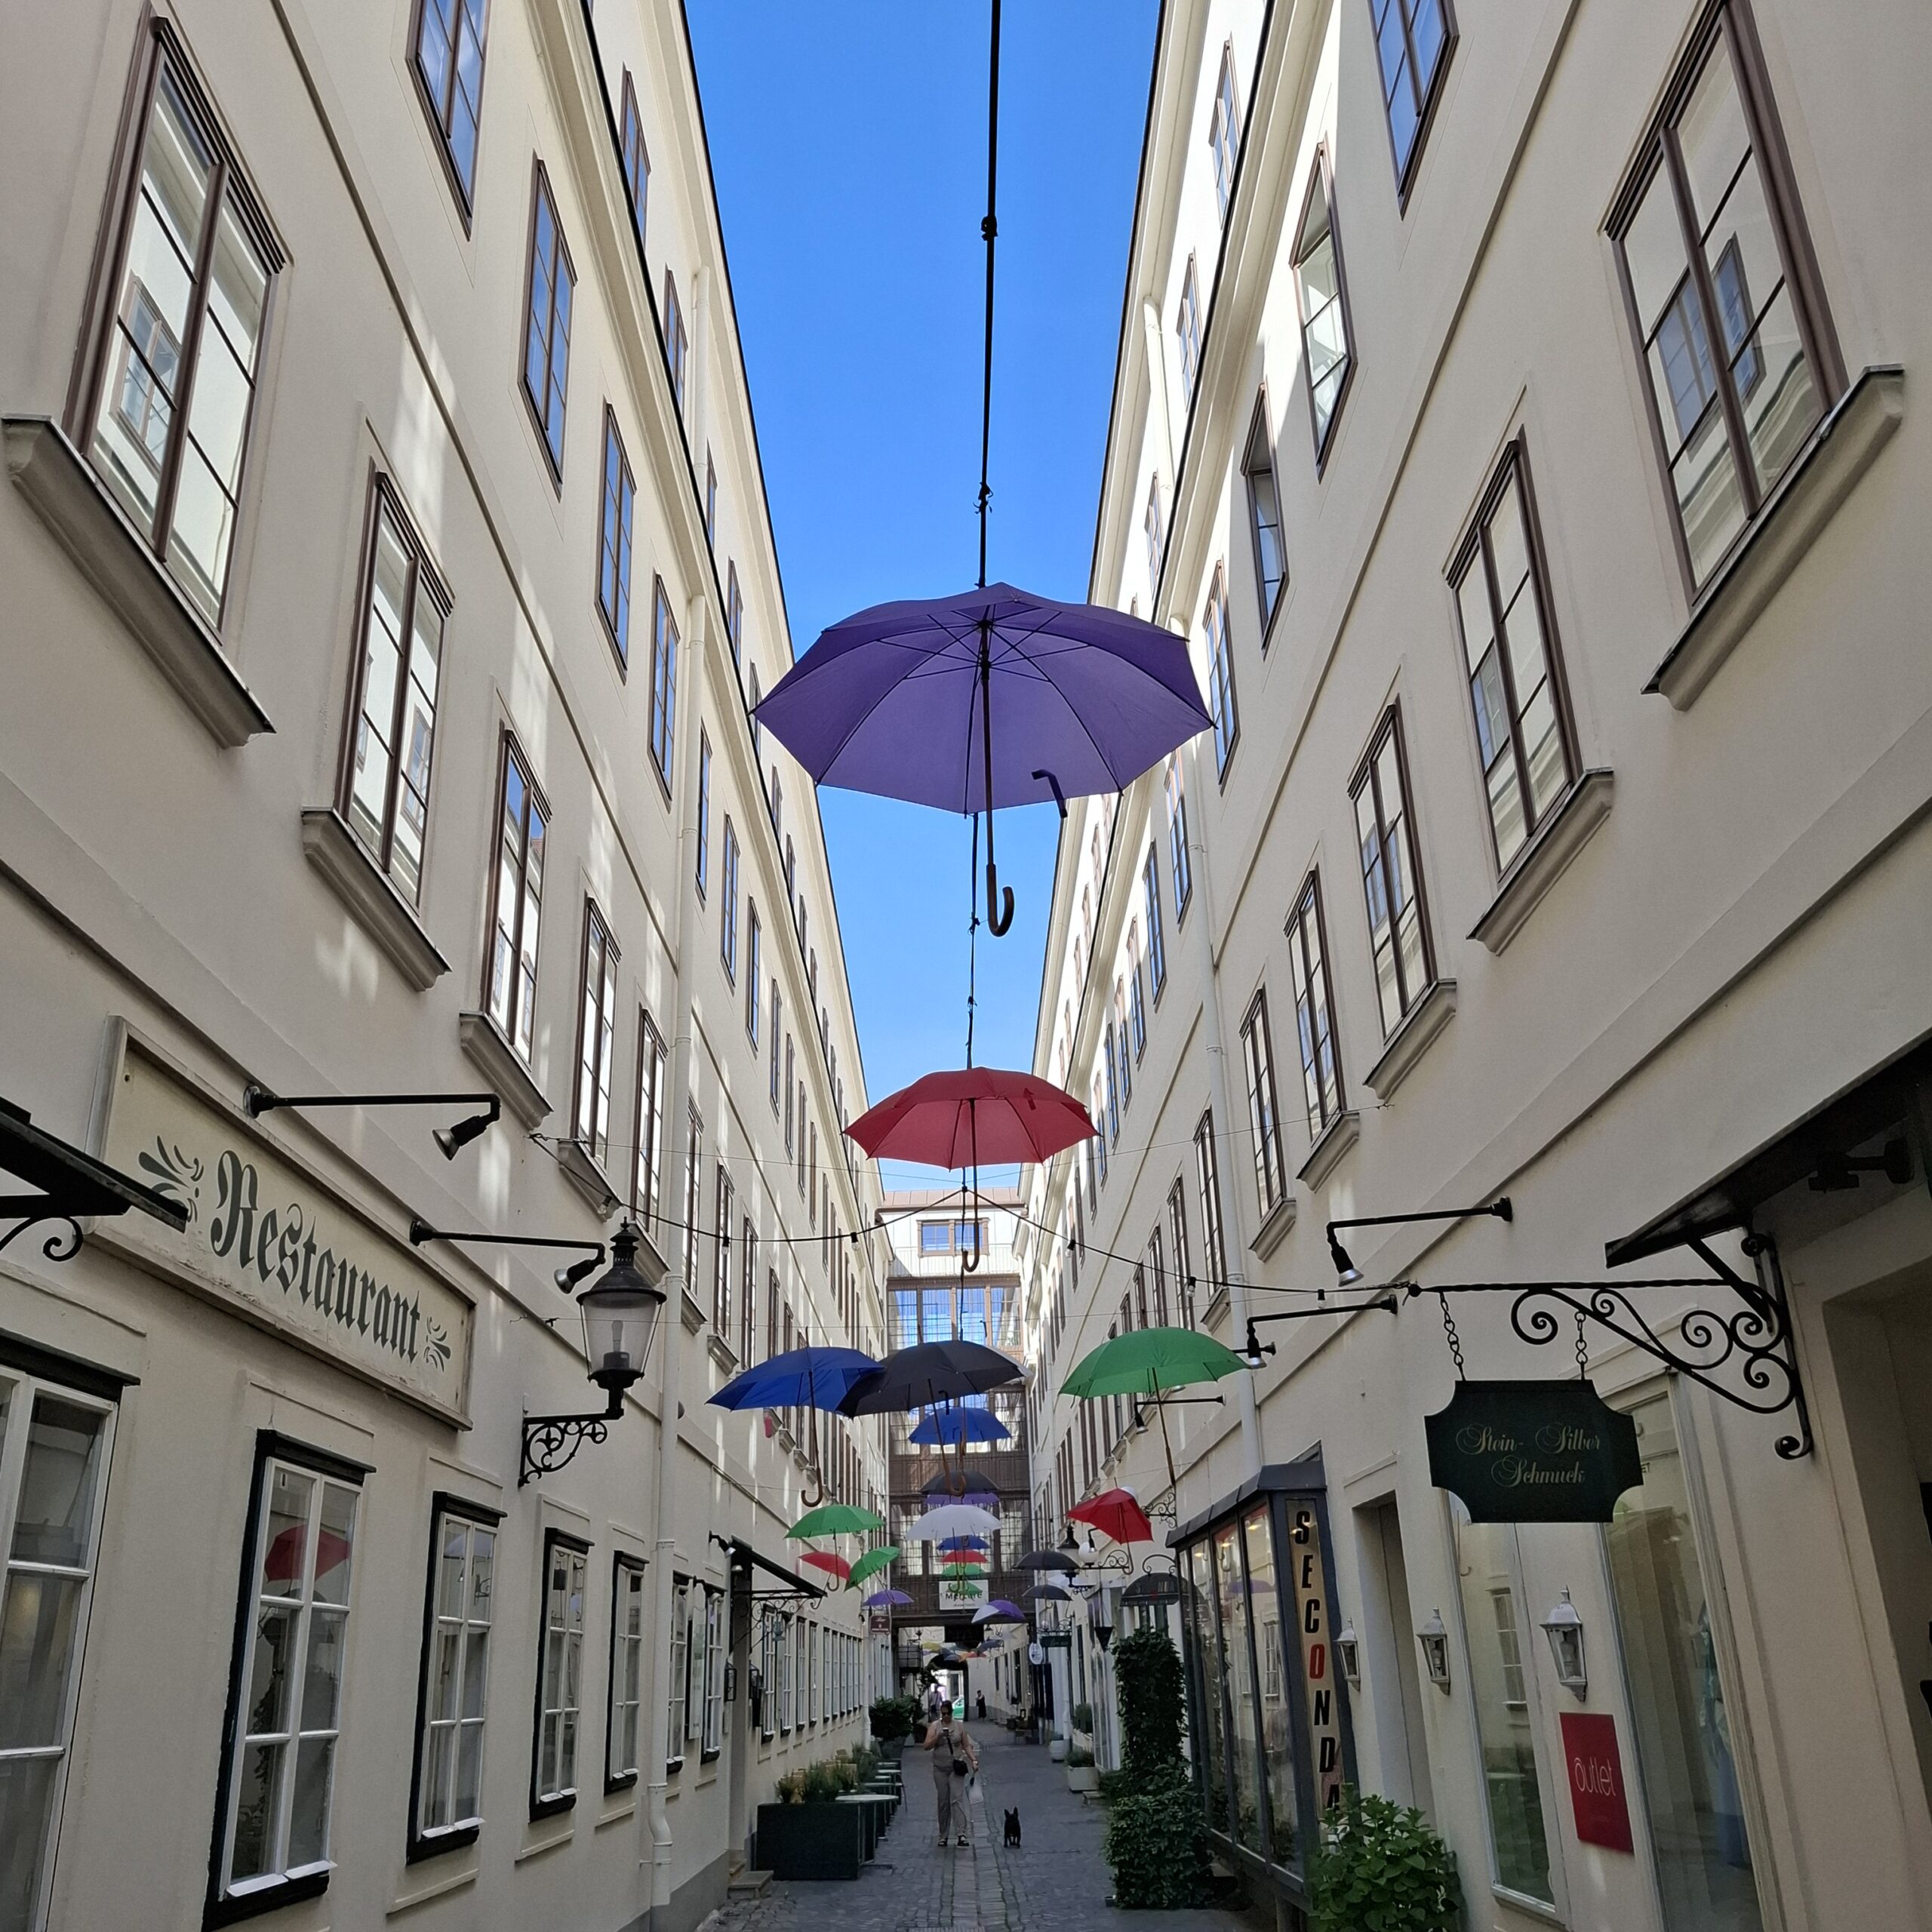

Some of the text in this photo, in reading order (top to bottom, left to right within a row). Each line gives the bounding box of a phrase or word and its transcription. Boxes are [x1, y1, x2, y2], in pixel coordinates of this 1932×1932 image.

[211, 1149, 421, 1364] Restaurant
[1535, 1422, 1601, 1454] Silber
[1491, 1455, 1586, 1487] Schmuck
